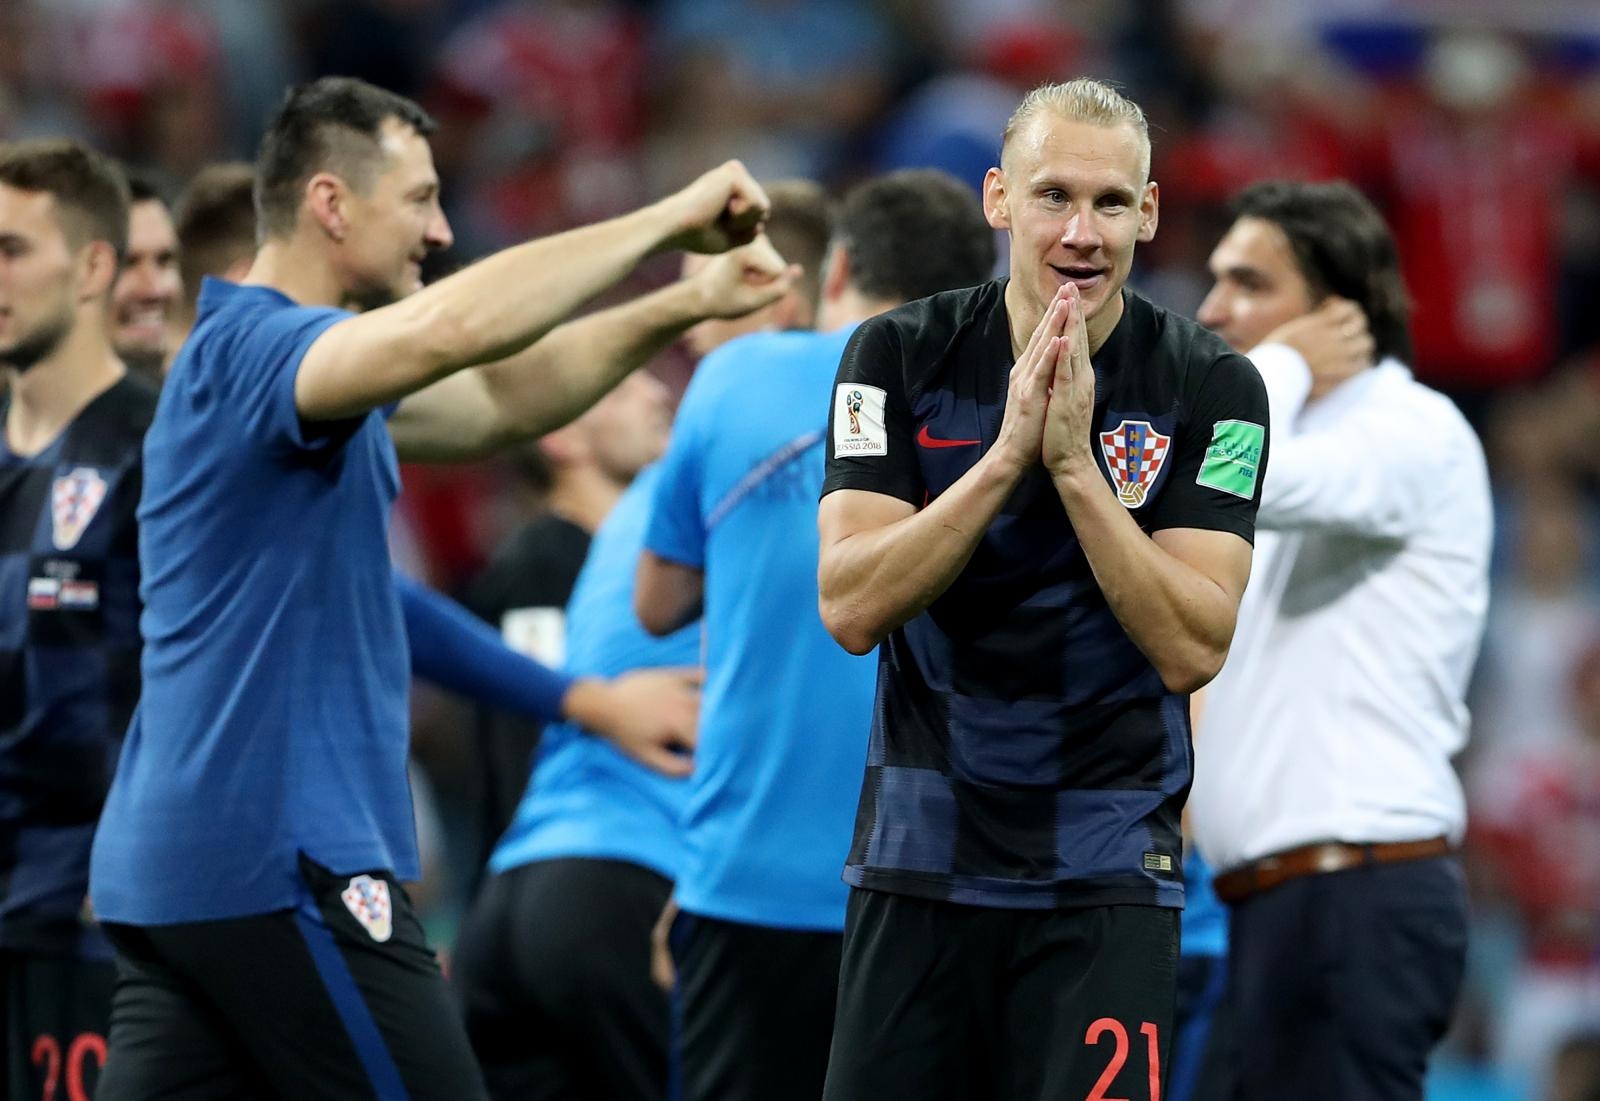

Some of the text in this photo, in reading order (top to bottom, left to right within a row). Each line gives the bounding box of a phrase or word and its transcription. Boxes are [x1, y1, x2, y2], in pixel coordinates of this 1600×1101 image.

[862, 442, 882, 450] 2018
[1129, 430, 1141, 473] HNS
[1239, 467, 1253, 478] FIFA
[1084, 1017, 1161, 1101] 21
